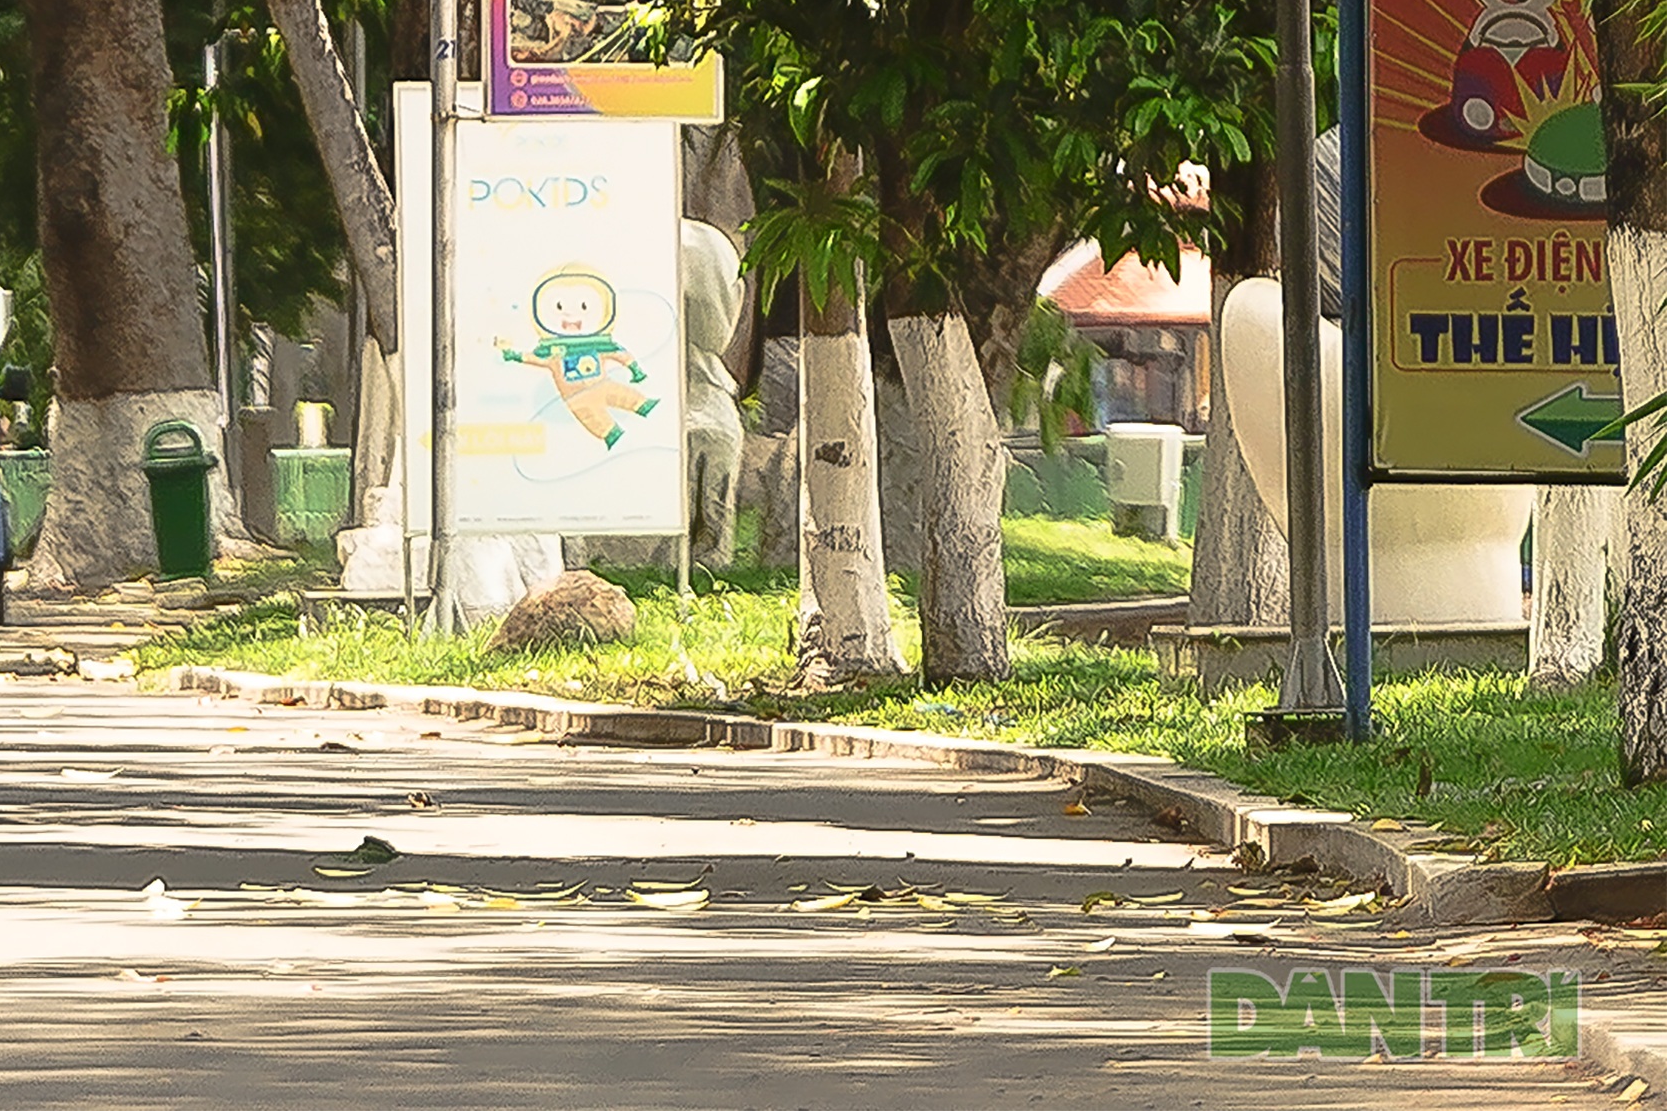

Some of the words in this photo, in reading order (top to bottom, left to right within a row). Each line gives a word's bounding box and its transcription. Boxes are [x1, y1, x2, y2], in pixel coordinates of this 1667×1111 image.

[468, 175, 610, 212] POKIDS
[1445, 238, 1494, 282] XE
[1504, 230, 1602, 294] ĐIỆN
[1409, 285, 1535, 364] THẾ
